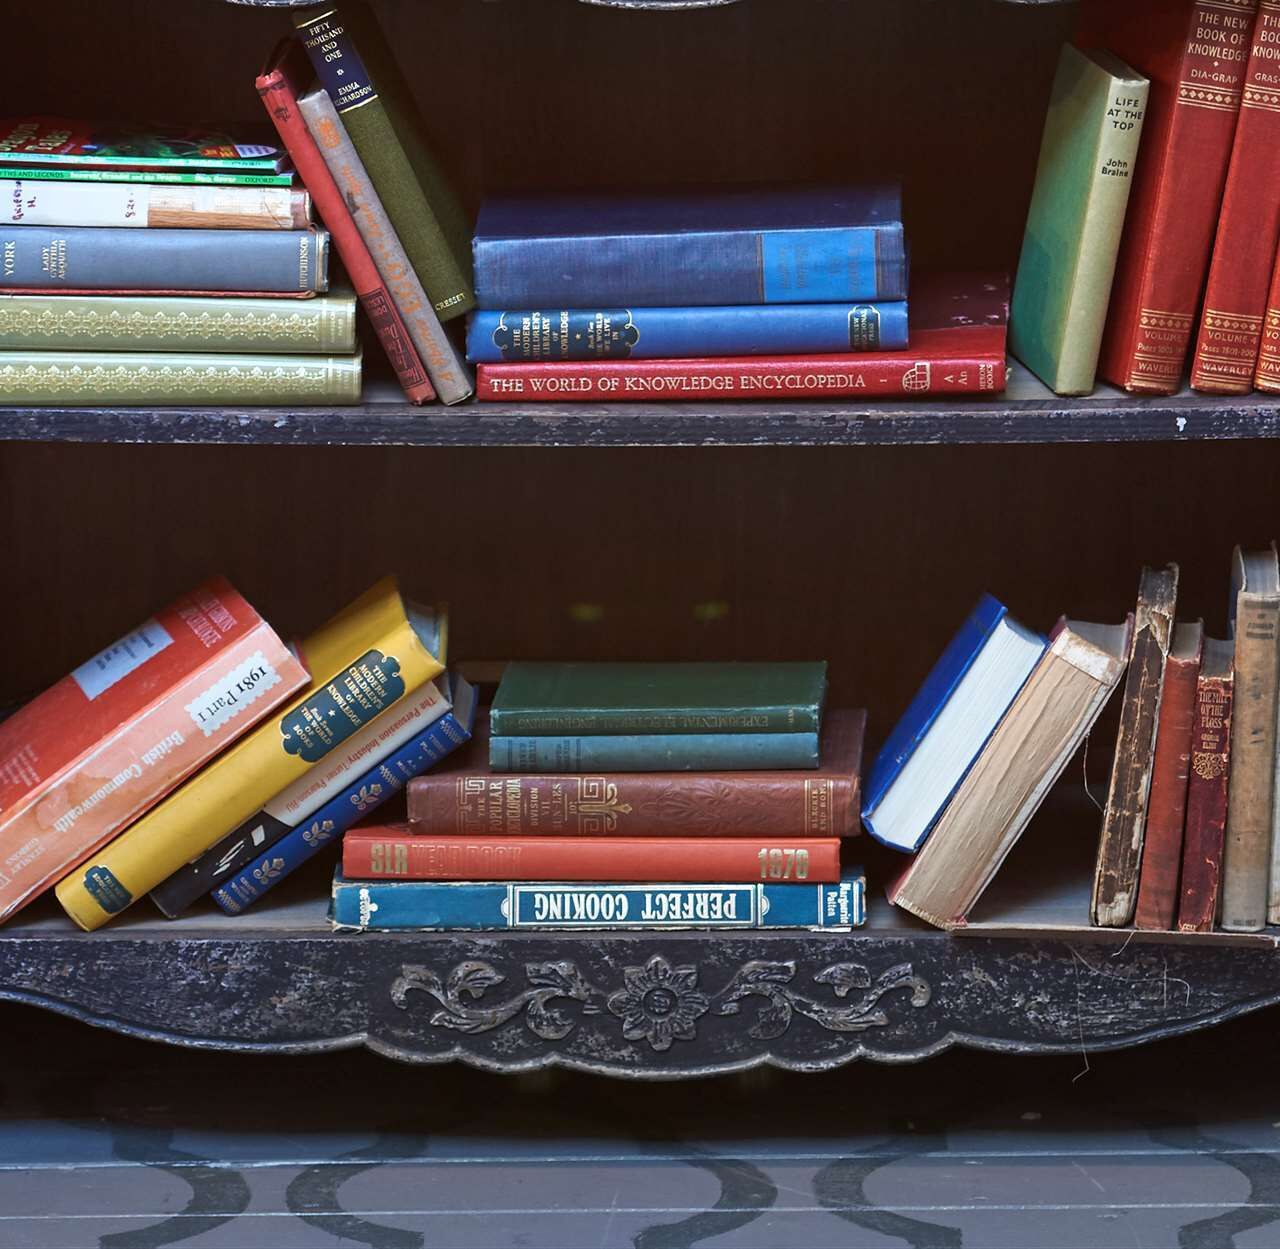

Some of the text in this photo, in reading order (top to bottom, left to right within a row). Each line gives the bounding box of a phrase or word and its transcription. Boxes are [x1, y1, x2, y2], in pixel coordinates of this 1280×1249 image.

[309, 22, 330, 36] FIFTY
[1199, 12, 1249, 30] THE NEW
[304, 26, 344, 49] THOUSAND
[1196, 28, 1245, 45] BOOK OF
[322, 41, 337, 53] AND
[324, 50, 342, 63] ONE
[1188, 42, 1248, 62] KNOWLEDGE
[1191, 69, 1238, 84] DIA-GRAP
[338, 81, 360, 96] EMMA
[1115, 97, 1139, 108] LIFE
[1107, 109, 1143, 120] AT THE
[1113, 121, 1134, 130] TOP
[1101, 167, 1129, 177] Braine
[1106, 158, 1128, 168] John
[34, 171, 65, 179] LEGENDS
[4, 240, 16, 276] YORK
[42, 247, 50, 272] LADY
[50, 240, 59, 279] CYNTHIA
[58, 240, 67, 280] ASQUITH
[299, 236, 309, 288] HUTCHINSON
[435, 292, 465, 311] CRESSET
[513, 328, 521, 348] THE
[532, 311, 541, 359] HILDREN'S
[542, 317, 550, 355] LIBRARY
[552, 331, 559, 342] OF
[560, 310, 569, 359] NOWLEDGE
[1208, 331, 1248, 344] VOLUME
[944, 374, 954, 383] A
[958, 371, 968, 385] An
[978, 363, 986, 390] HERON
[986, 364, 994, 390] BOOKS
[1202, 363, 1254, 376] WAVERLEY
[491, 379, 524, 392] THE
[530, 378, 592, 392] WORLD
[598, 377, 619, 391] OF
[624, 376, 734, 392] KNOWLEDGE
[740, 374, 866, 390] ENCYCLOPEDIA
[236, 666, 268, 694] 1981
[359, 664, 387, 698] MODERN
[372, 665, 388, 684] THE
[344, 677, 372, 710] LIBRARY
[349, 667, 384, 710] CHILDREN'S
[1198, 691, 1212, 703] THE
[206, 691, 238, 716] Part
[327, 684, 362, 727] KNOWLEDGE
[345, 694, 356, 704] OF
[420, 697, 437, 711] The
[1209, 704, 1224, 716] THE
[301, 706, 332, 745] THE WORLD
[304, 726, 314, 735] OF
[380, 708, 421, 742] Persuasion
[518, 717, 596, 729] ENGINEERING
[682, 715, 768, 728] EXPERIMENTAL
[1201, 717, 1222, 728] FLOSS
[293, 724, 314, 748] BOOKS
[141, 729, 186, 767] British
[53, 763, 143, 833] Commonwealth
[478, 797, 486, 817] THE
[489, 781, 503, 831] POPULAR
[530, 787, 539, 827] DIVISION
[542, 801, 550, 816] VII
[371, 843, 408, 875] SLR
[534, 892, 737, 921] PERFECT COOKING
[827, 891, 838, 917] Patten
[838, 883, 851, 924] Marguerite
